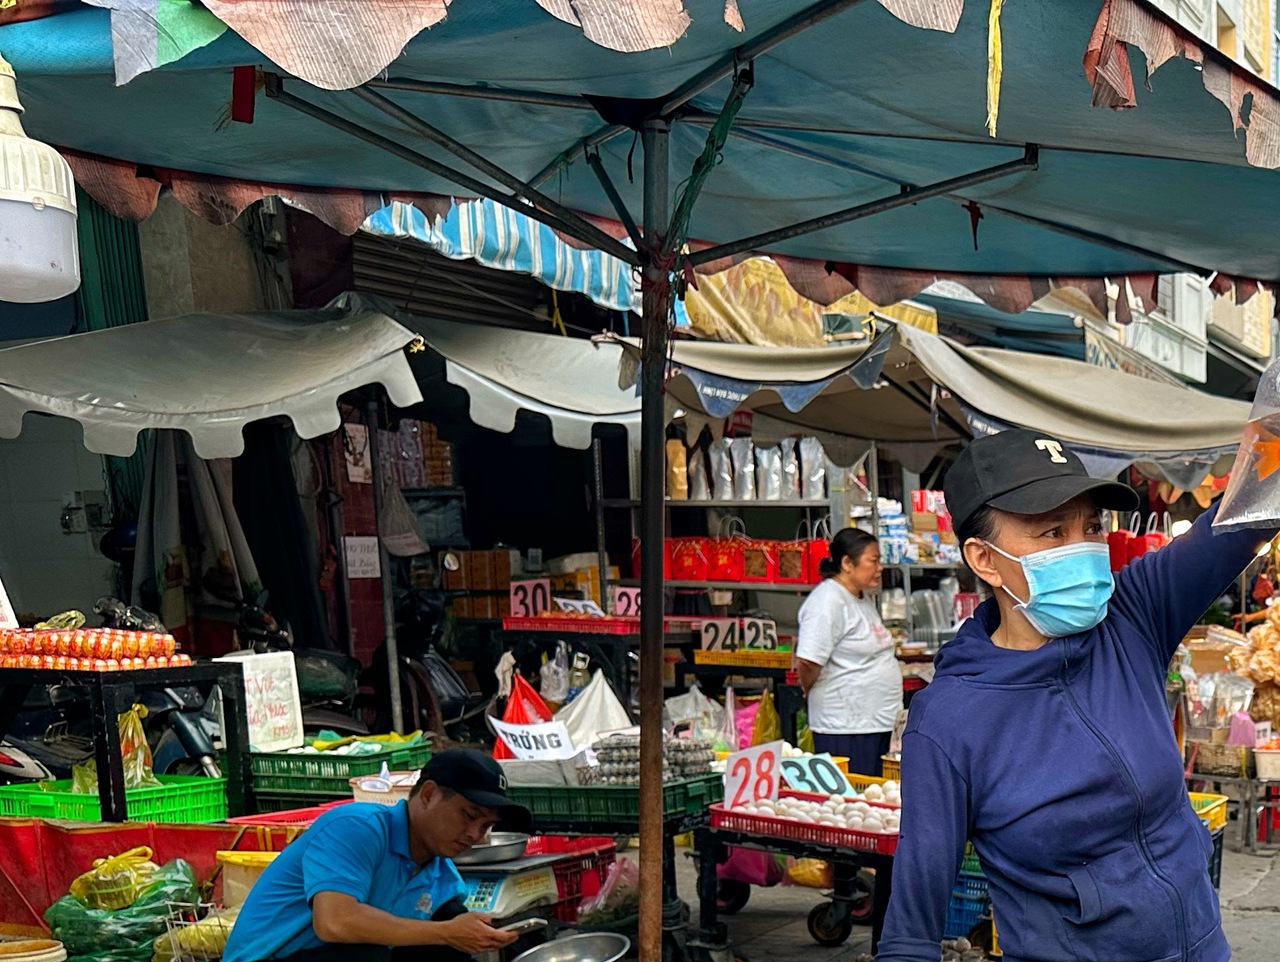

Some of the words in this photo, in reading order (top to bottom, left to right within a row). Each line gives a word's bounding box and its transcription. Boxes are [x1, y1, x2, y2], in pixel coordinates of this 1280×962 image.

[1034, 440, 1068, 463] T
[513, 583, 548, 617] 30
[703, 621, 739, 652] 24
[746, 620, 777, 650] 25
[503, 729, 562, 751] TRỨNG
[730, 750, 776, 811] 28
[781, 757, 847, 795] 30
